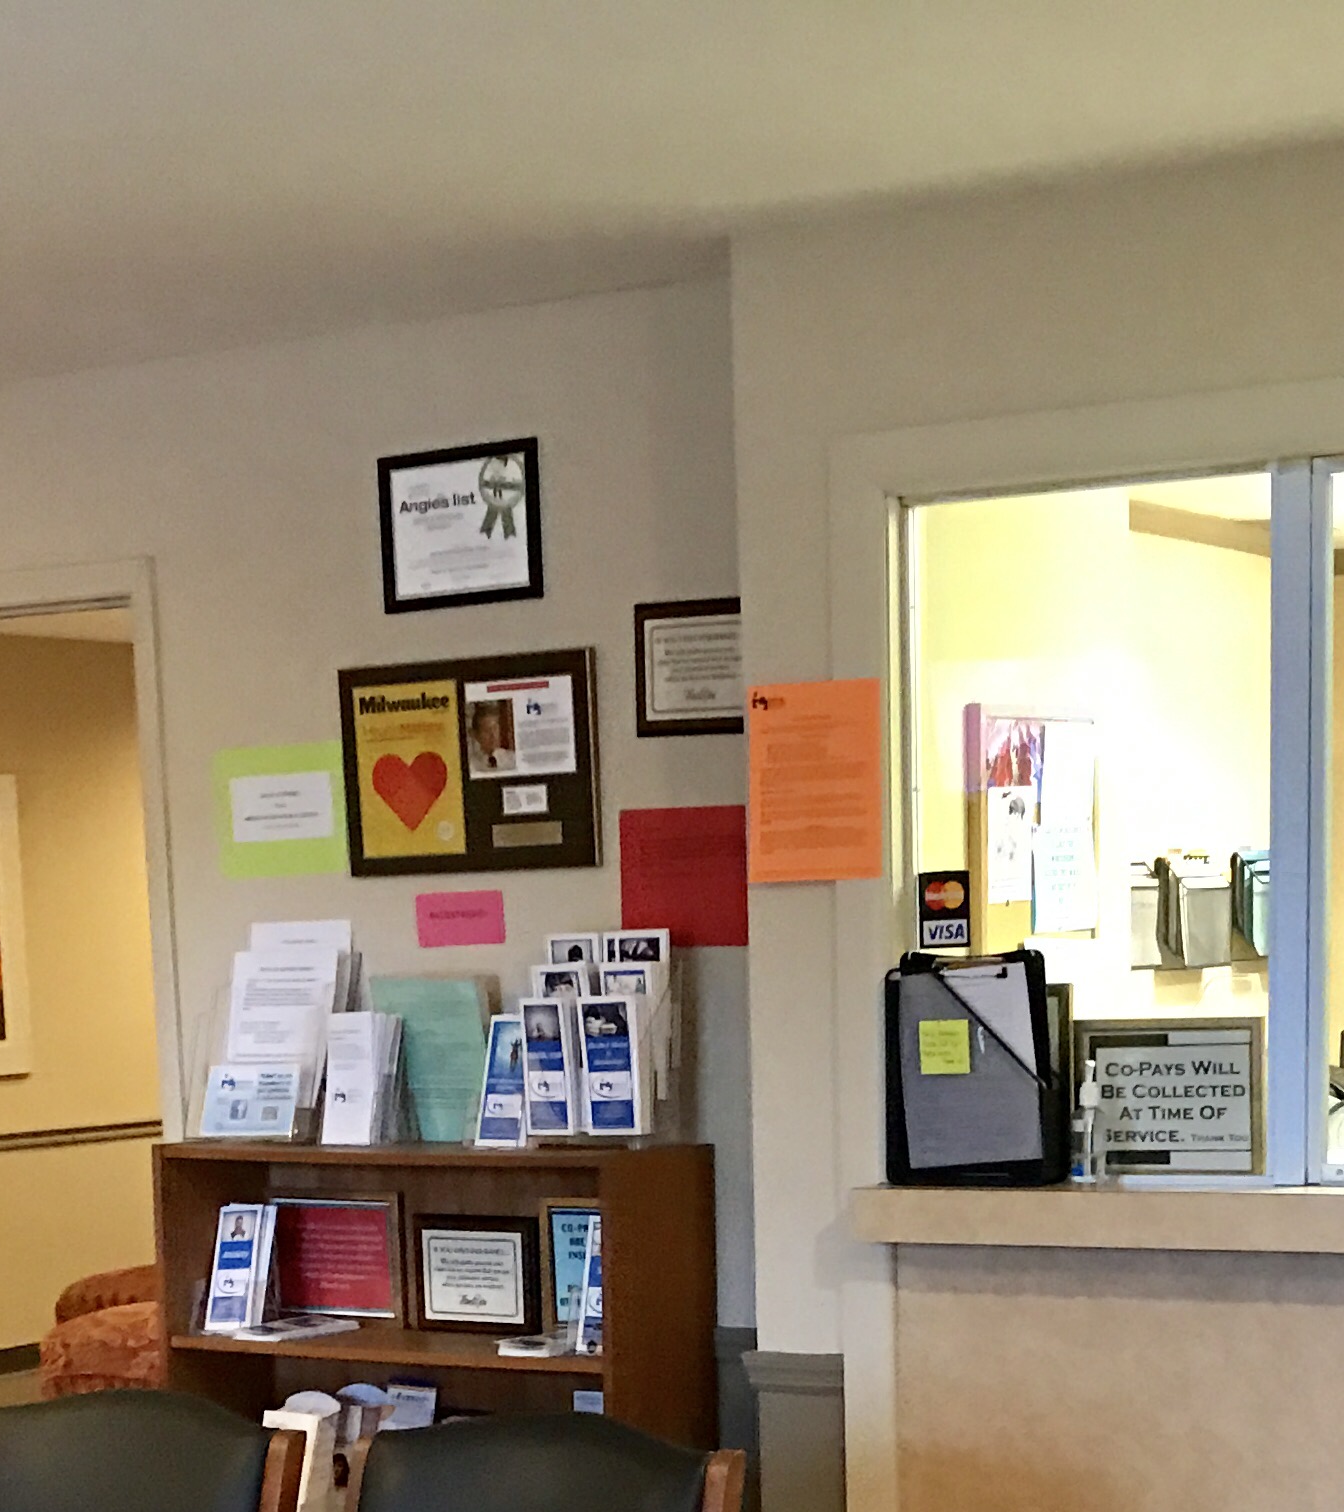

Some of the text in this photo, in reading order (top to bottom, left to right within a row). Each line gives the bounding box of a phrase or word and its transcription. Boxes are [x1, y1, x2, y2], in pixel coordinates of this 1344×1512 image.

[358, 691, 450, 715] Milwaukee
[928, 923, 965, 940] VISA
[1191, 1060, 1241, 1075] WILL
[1101, 1084, 1246, 1099] BE COLLECTED
[1119, 1105, 1228, 1121] AT TIME OF
